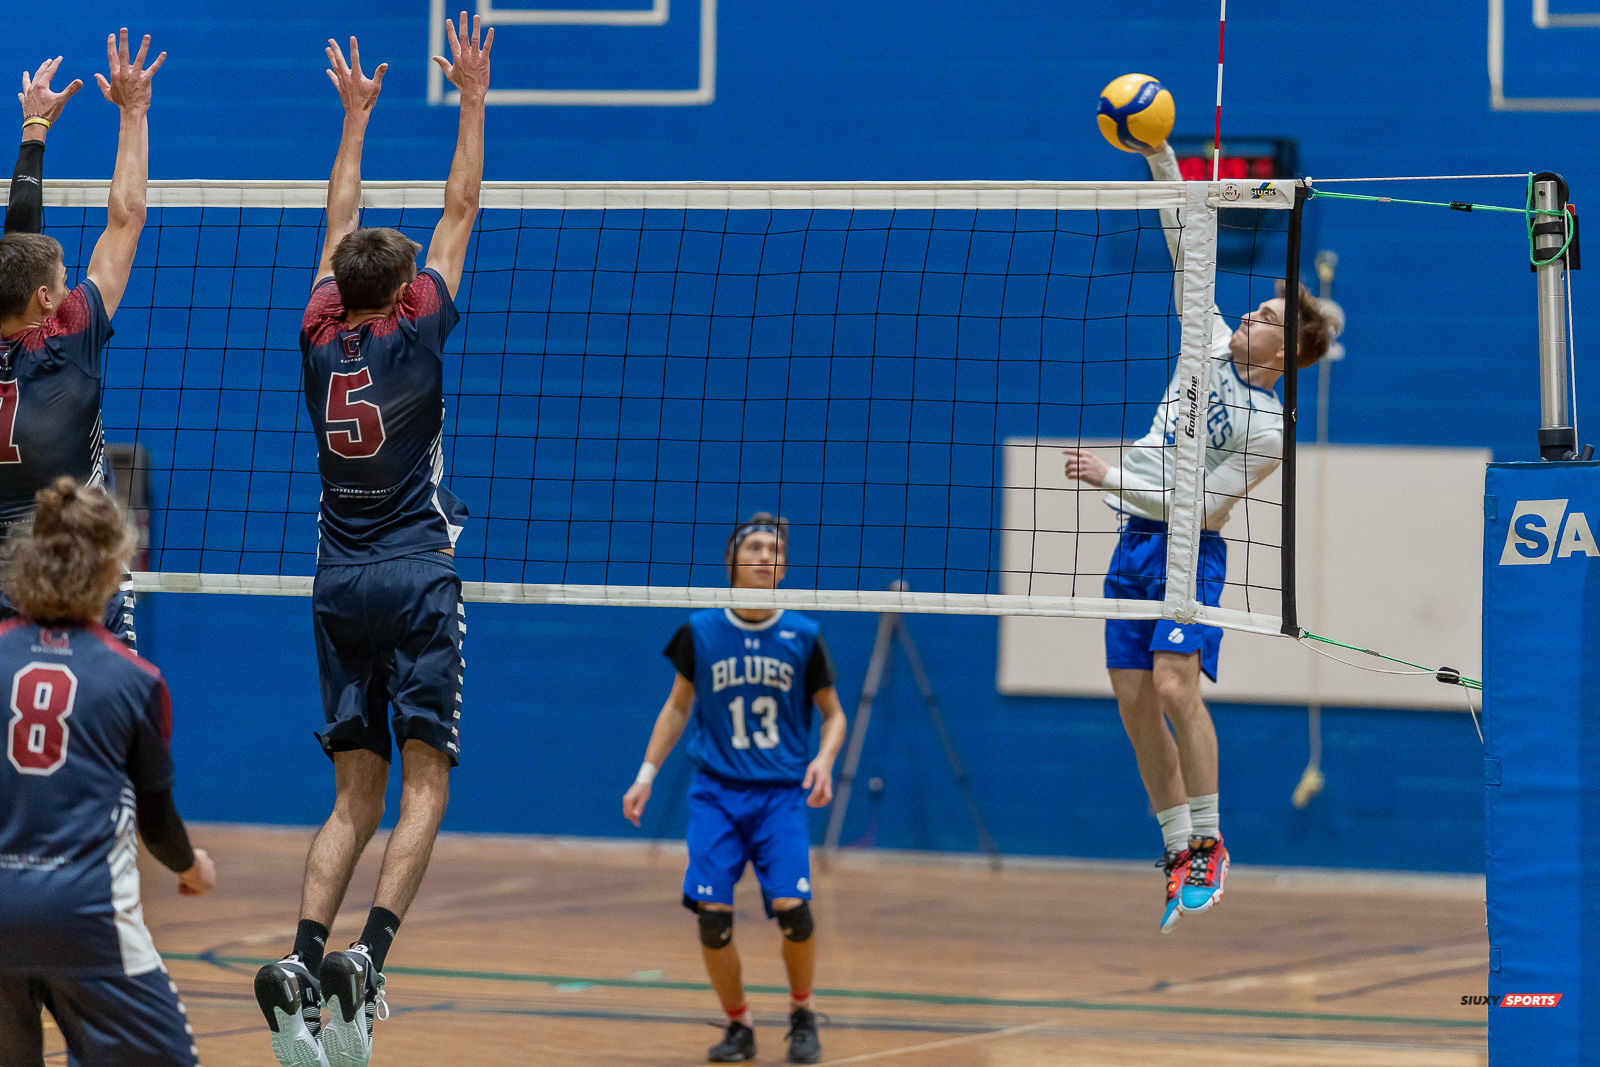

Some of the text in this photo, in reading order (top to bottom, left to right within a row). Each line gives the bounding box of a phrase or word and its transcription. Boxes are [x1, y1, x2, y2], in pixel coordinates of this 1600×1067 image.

[1251, 188, 1276, 197] HUCK
[326, 366, 387, 459] 5
[711, 655, 795, 693] BLUES
[7, 661, 78, 776] 8
[728, 696, 780, 749] 13
